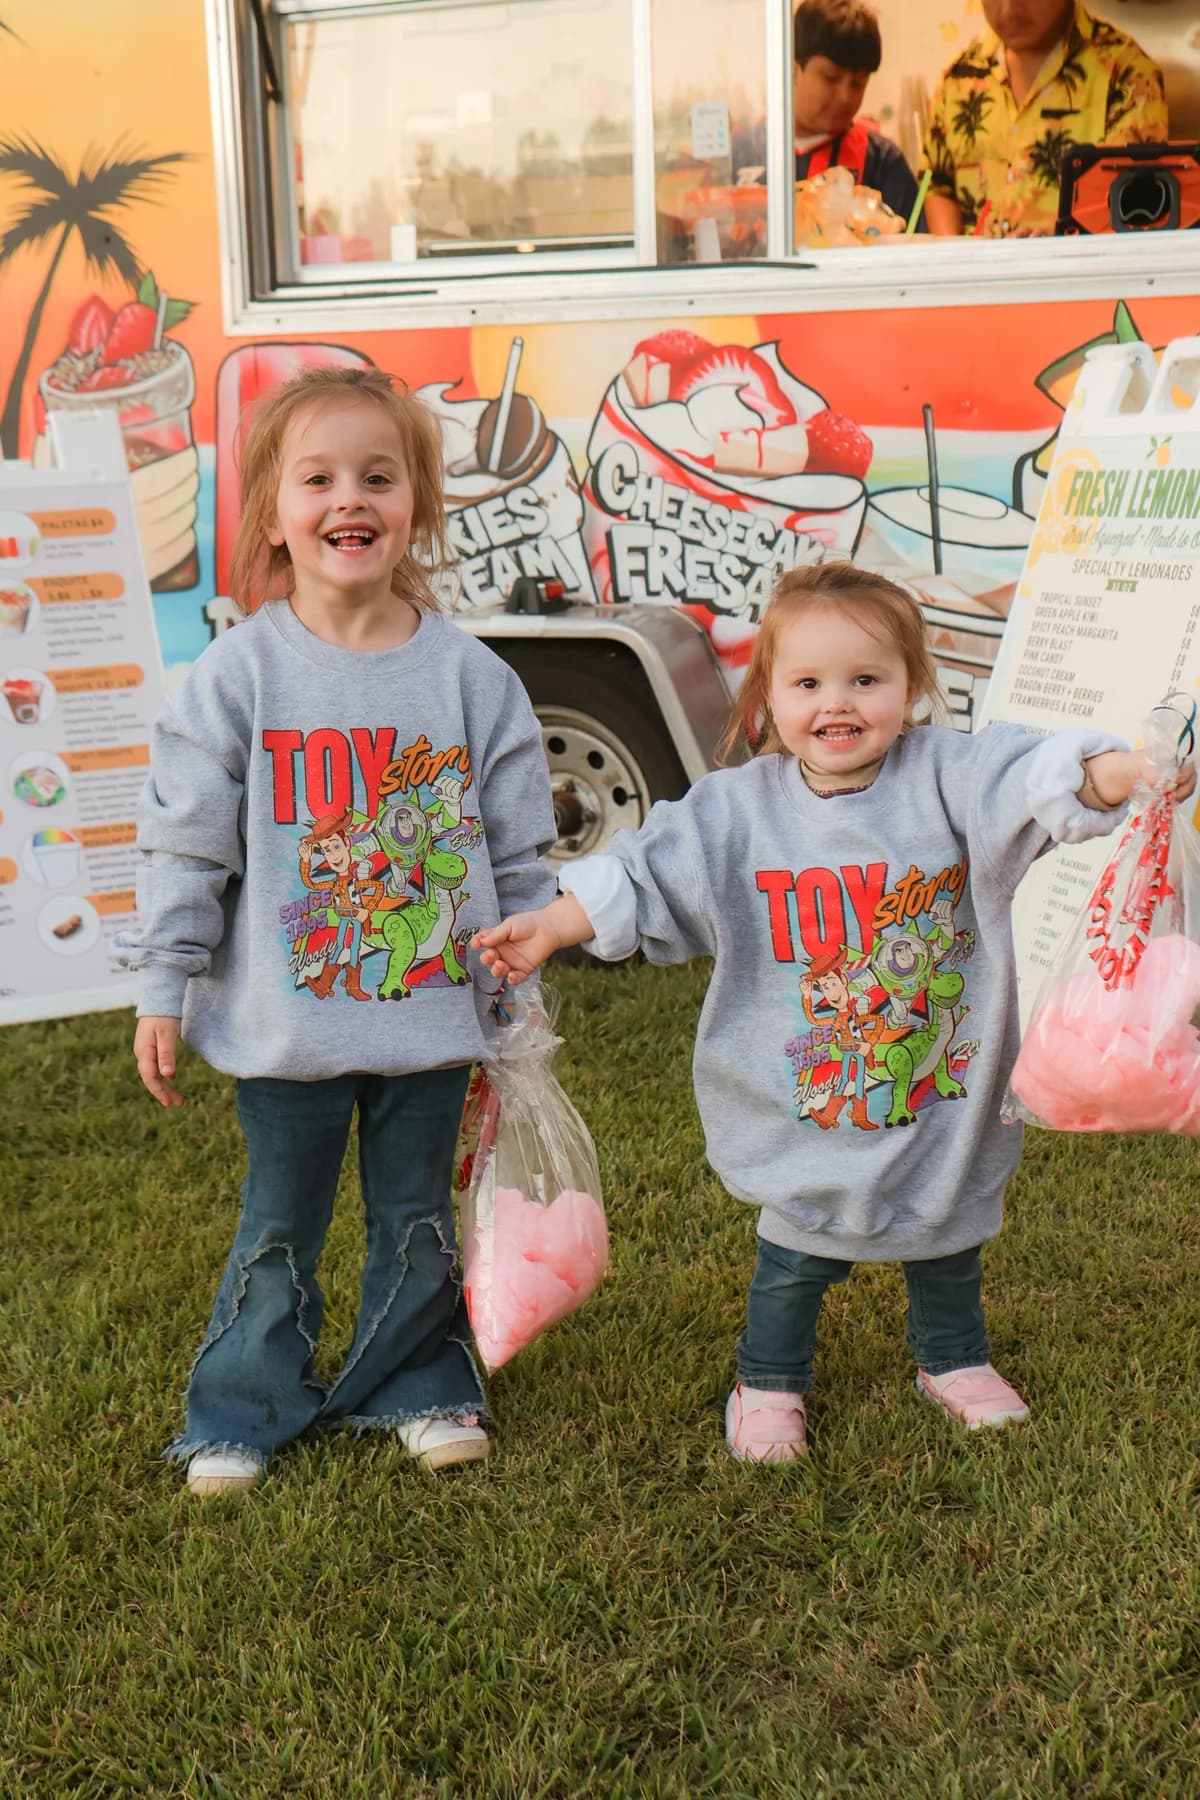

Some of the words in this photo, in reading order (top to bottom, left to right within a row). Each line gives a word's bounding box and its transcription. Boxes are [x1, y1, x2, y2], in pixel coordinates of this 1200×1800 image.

[592, 441, 840, 571] CHEESECAK
[1064, 469, 1130, 517] FRESH
[606, 523, 776, 624] FRESA
[1072, 559, 1127, 577] SPECIALTY
[1128, 561, 1193, 581] LEMONADES
[1035, 605, 1057, 619] GREEN
[1058, 608, 1080, 622] APPLE
[1081, 611, 1099, 623] KIWI
[1040, 591, 1072, 606] TROPICAL
[1074, 596, 1102, 609] SUNSET
[1027, 635, 1049, 648] BERRY
[1049, 638, 1073, 652] BLAST
[1031, 620, 1052, 633] SPICY
[1053, 623, 1076, 637] PEACH
[1076, 627, 1119, 641] MARGARITA
[1023, 648, 1040, 661] PINK
[1040, 651, 1064, 664] CANDY
[1018, 664, 1050, 679] COCONUT
[1050, 668, 1076, 682] CREAM
[1009, 692, 1060, 712] STRAWBERRIES
[1068, 702, 1095, 718] CREAM
[1014, 677, 1042, 692] DRAGON
[1043, 681, 1066, 697] BERRY
[1073, 687, 1104, 704] BERRIES
[262, 727, 398, 824] TOY
[377, 734, 473, 796] story
[279, 888, 333, 925] SINCE
[755, 862, 889, 963] TOY
[872, 855, 969, 930] story
[286, 911, 329, 946] 1995
[287, 937, 340, 976] Woody
[784, 1024, 834, 1057] SINCE
[791, 1046, 832, 1077] 1995
[792, 1071, 842, 1107] Woody
